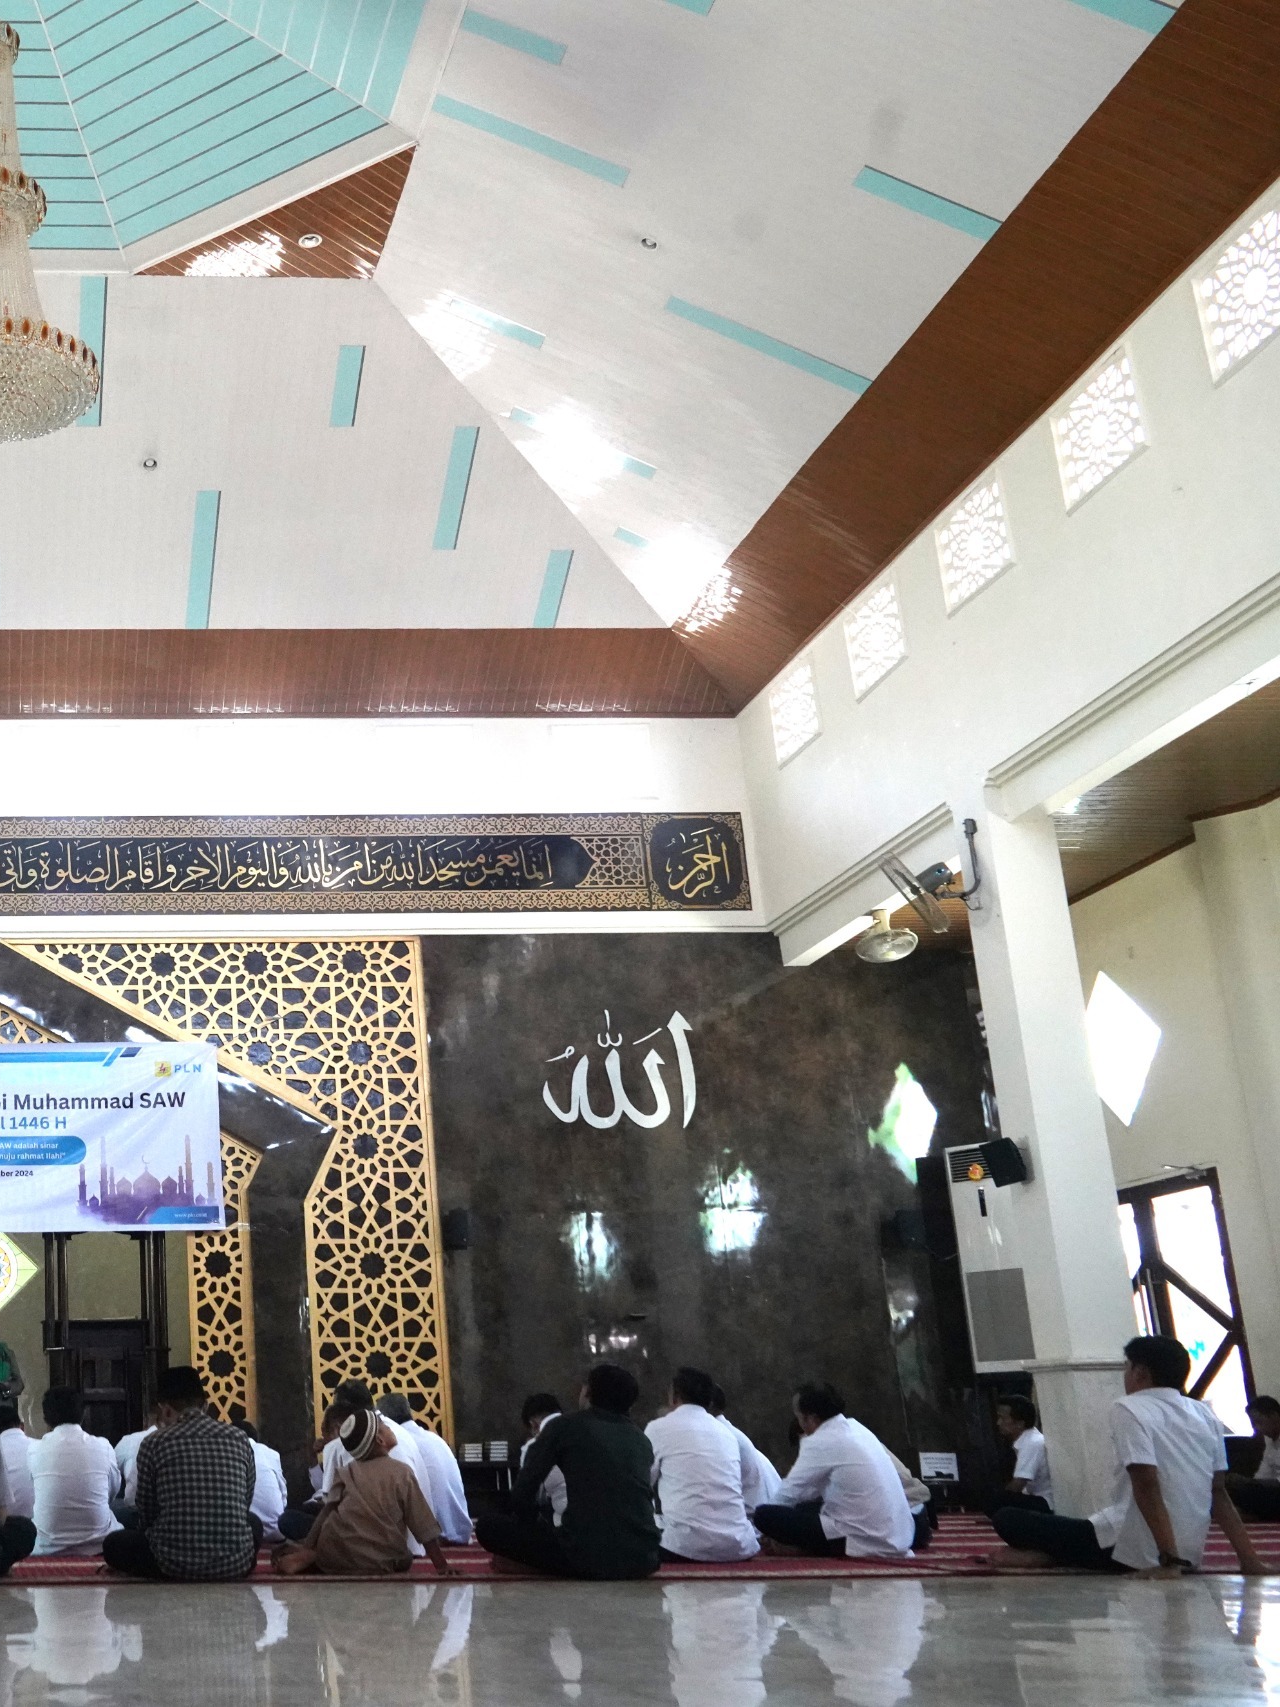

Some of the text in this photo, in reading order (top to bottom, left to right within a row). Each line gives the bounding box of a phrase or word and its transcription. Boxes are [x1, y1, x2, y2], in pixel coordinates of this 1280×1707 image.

[174, 1064, 202, 1073] PLN
[542, 1009, 697, 1130] الله
[14, 1092, 134, 1110] Muhammad
[139, 1091, 186, 1109] SAW
[10, 1117, 50, 1130] 1446
[55, 1116, 67, 1129] H
[13, 1142, 39, 1150] adalah
[17, 1152, 45, 1160] rahmat
